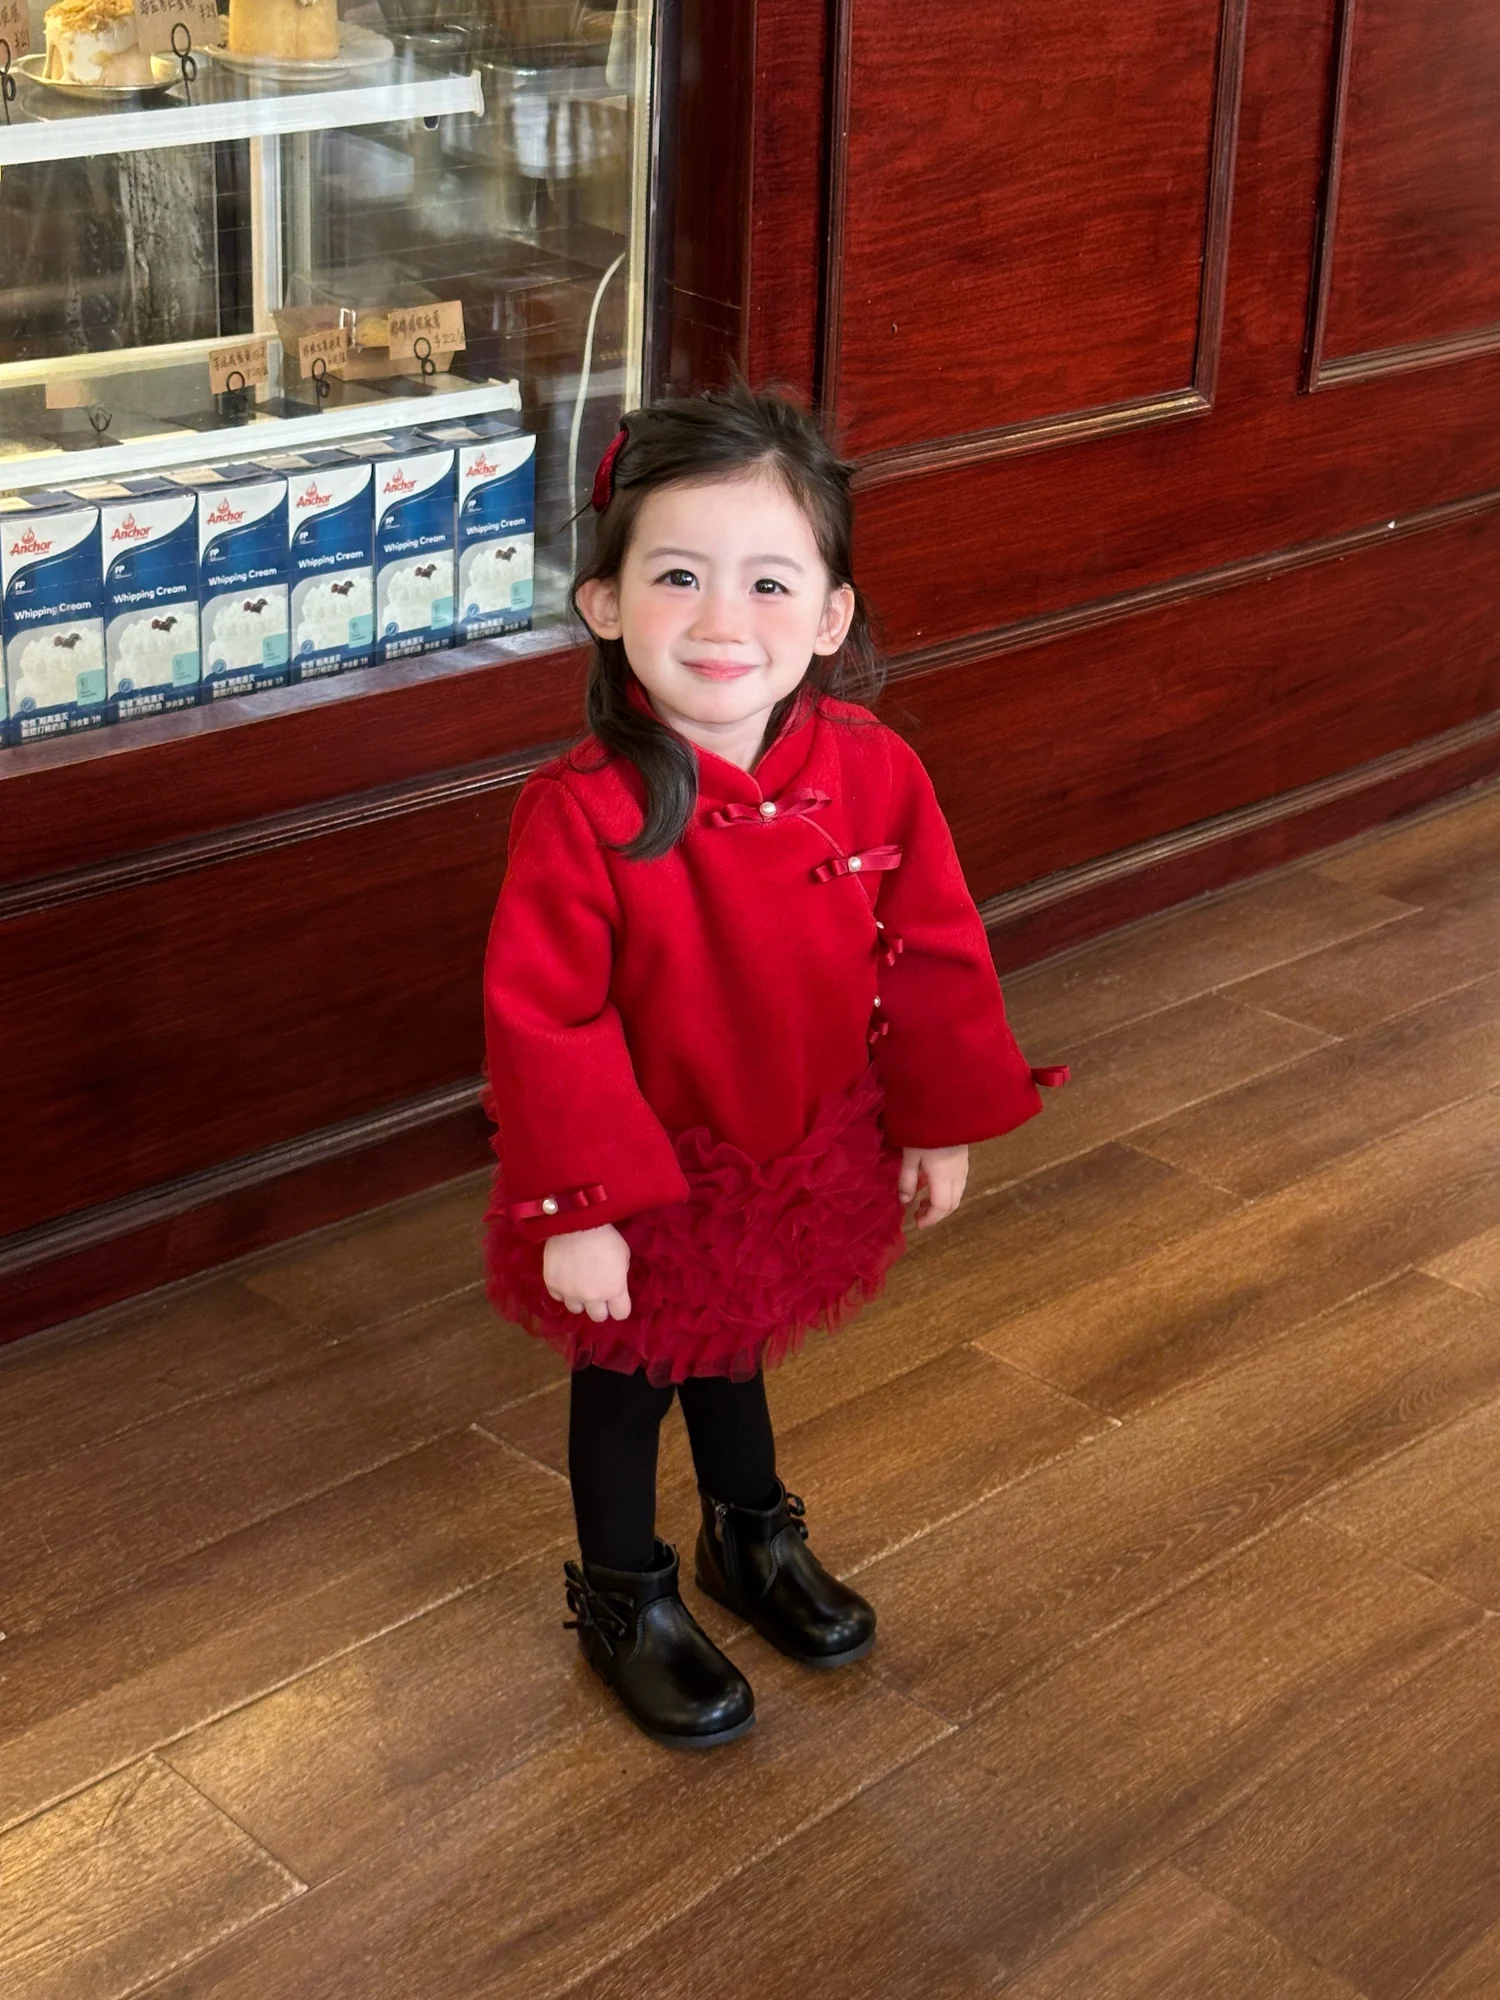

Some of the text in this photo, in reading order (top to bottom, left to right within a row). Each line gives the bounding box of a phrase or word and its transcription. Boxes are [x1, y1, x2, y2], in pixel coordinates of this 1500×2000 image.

[465, 464, 499, 478] Anchor
[383, 480, 416, 494] Anchor
[296, 494, 332, 509] Anchor
[207, 510, 245, 525] Anchor
[111, 526, 152, 542] Anchor
[465, 518, 526, 535] Whipping Cream
[10, 540, 51, 556] Anchor
[383, 534, 446, 553] Whipping Cream
[210, 548, 220, 557] FP
[297, 550, 364, 568] Whipping Cream
[115, 565, 125, 574] FP
[208, 568, 277, 586] Whipping Cream
[15, 581, 25, 590] FP
[113, 585, 187, 603] Whipping Cream
[14, 601, 92, 620] Whipping Cream
